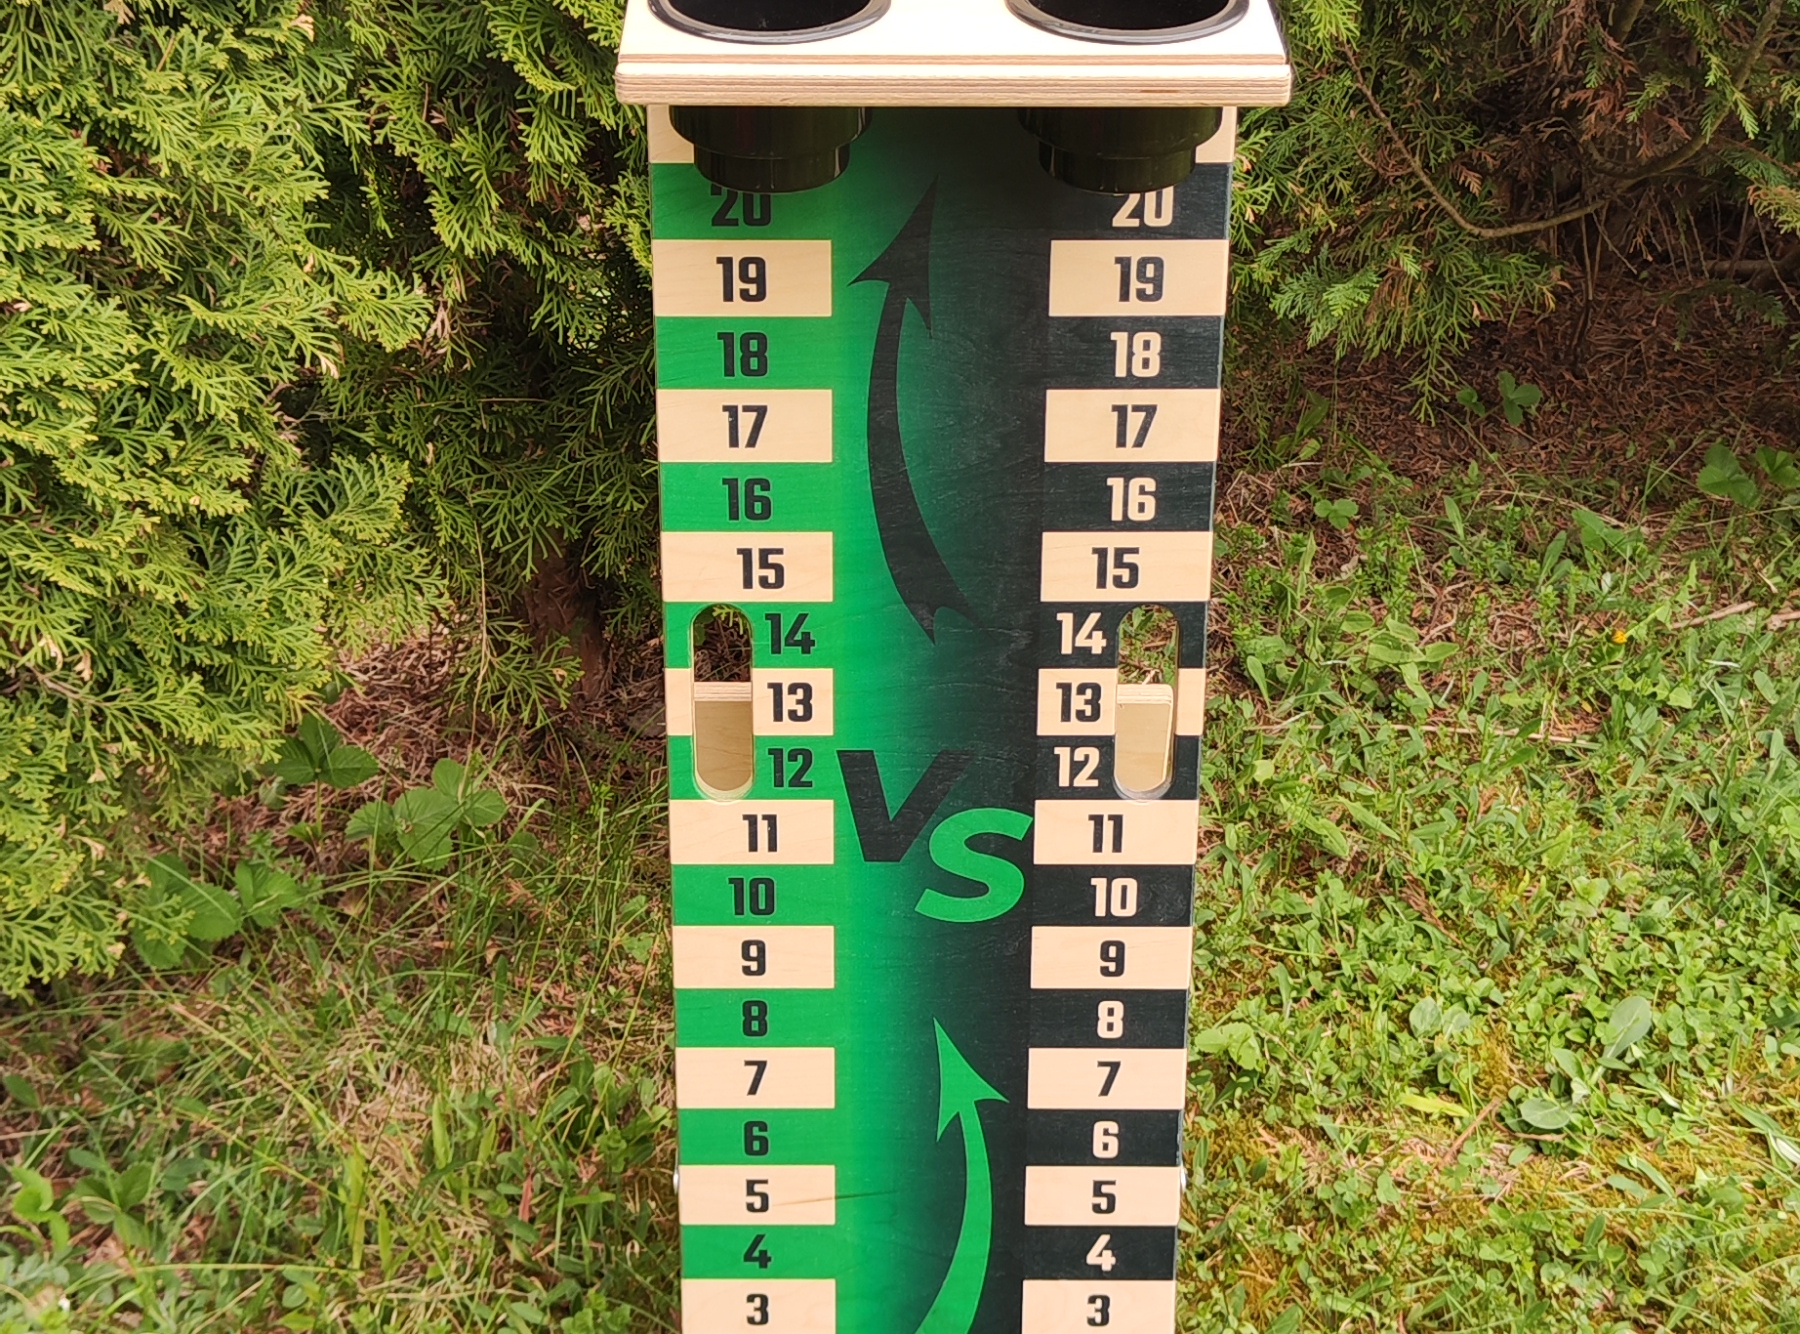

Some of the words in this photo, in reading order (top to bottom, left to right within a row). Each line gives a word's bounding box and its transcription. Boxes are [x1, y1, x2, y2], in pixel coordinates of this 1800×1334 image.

[710, 185, 771, 227] 20
[1112, 185, 1174, 227] 20
[716, 256, 767, 303] 19
[1115, 256, 1164, 303] 19
[717, 331, 769, 377] 18
[1110, 331, 1162, 378] 18
[722, 405, 768, 448] 17
[1111, 403, 1158, 448] 17
[722, 478, 772, 521] 16
[1107, 477, 1157, 521] 16
[736, 547, 786, 590] 15
[1091, 546, 1140, 590] 15
[765, 613, 816, 654] 14
[1056, 612, 1106, 655] 14
[767, 682, 814, 723] 13
[1055, 681, 1102, 723] 13
[768, 747, 814, 788] 12
[1053, 746, 1100, 789] 12
[742, 813, 778, 853] 11
[836, 749, 1033, 923] VS
[1088, 813, 1123, 854] 11
[728, 876, 776, 916] 10
[1090, 876, 1138, 917] 10
[740, 939, 767, 977] 9
[1099, 939, 1126, 978] 9
[742, 1000, 769, 1038] 8
[1097, 1000, 1124, 1039] 8
[743, 1060, 768, 1096] 7
[1097, 1060, 1121, 1097] 7
[743, 1121, 769, 1157] 6
[1092, 1121, 1119, 1159] 6
[745, 1179, 770, 1214] 5
[1090, 1179, 1117, 1215] 5
[743, 1234, 772, 1269] 4
[1086, 1234, 1116, 1272] 4
[746, 1293, 770, 1327] 3
[1087, 1293, 1111, 1328] 3
